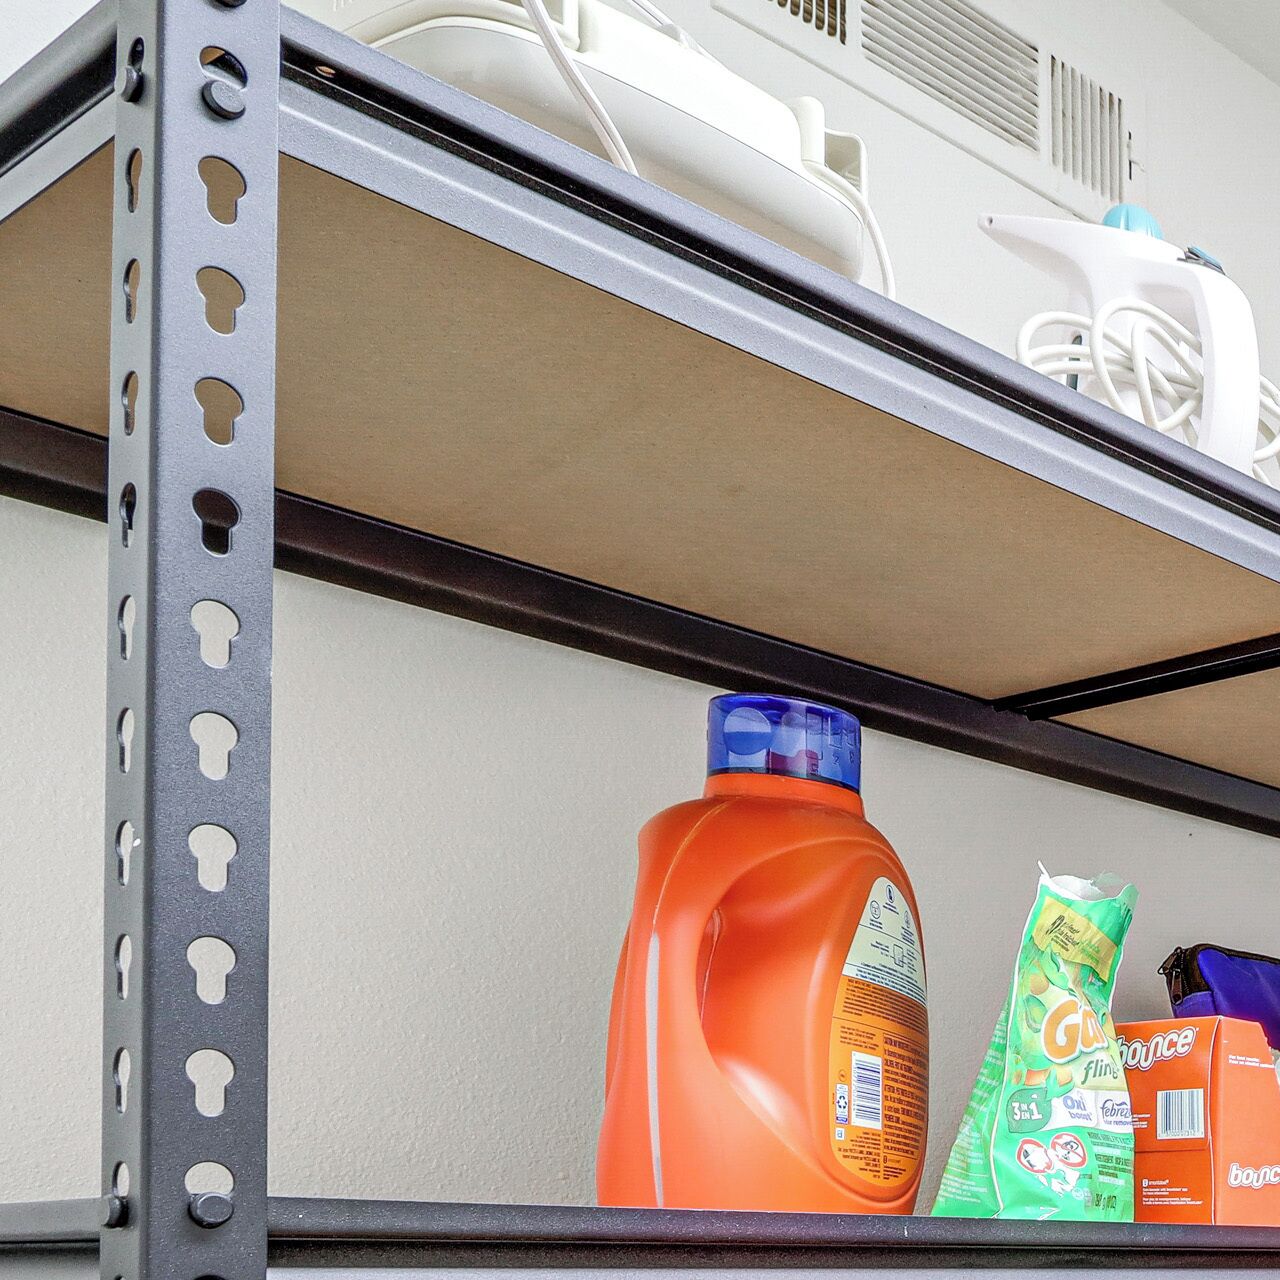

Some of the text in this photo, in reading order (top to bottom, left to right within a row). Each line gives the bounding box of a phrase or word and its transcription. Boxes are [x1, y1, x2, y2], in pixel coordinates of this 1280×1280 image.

[1118, 1026, 1196, 1070] bounce
[1011, 1101, 1021, 1120] 3
[1029, 1101, 1042, 1120] 1
